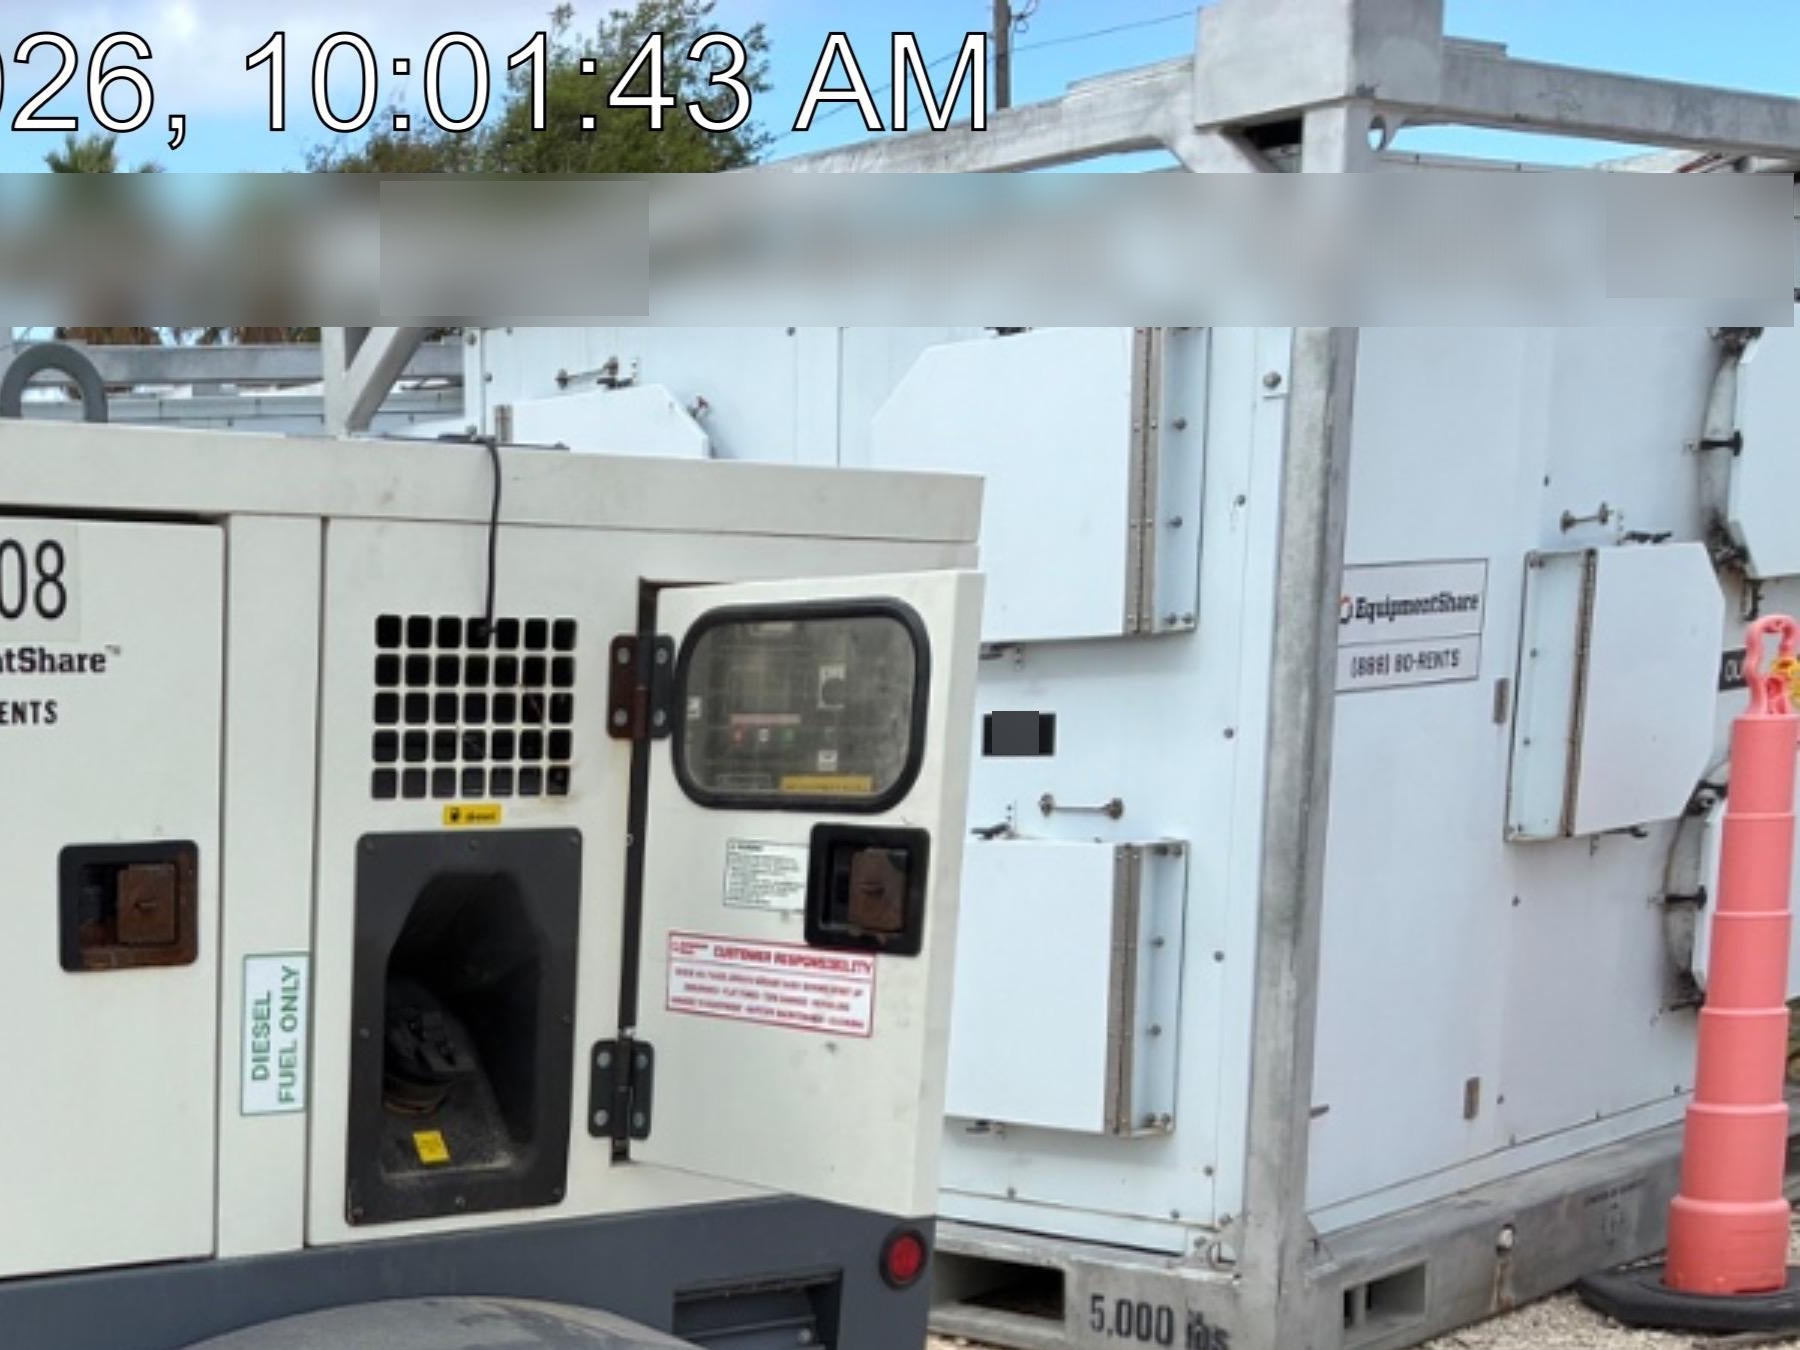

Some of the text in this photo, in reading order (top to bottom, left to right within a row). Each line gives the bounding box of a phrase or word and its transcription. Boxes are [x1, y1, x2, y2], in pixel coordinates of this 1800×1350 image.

[1355, 592, 1478, 623] EquipmentShare
[251, 990, 272, 1081] DIESEL
[276, 964, 300, 1104] FUEL ONLY
